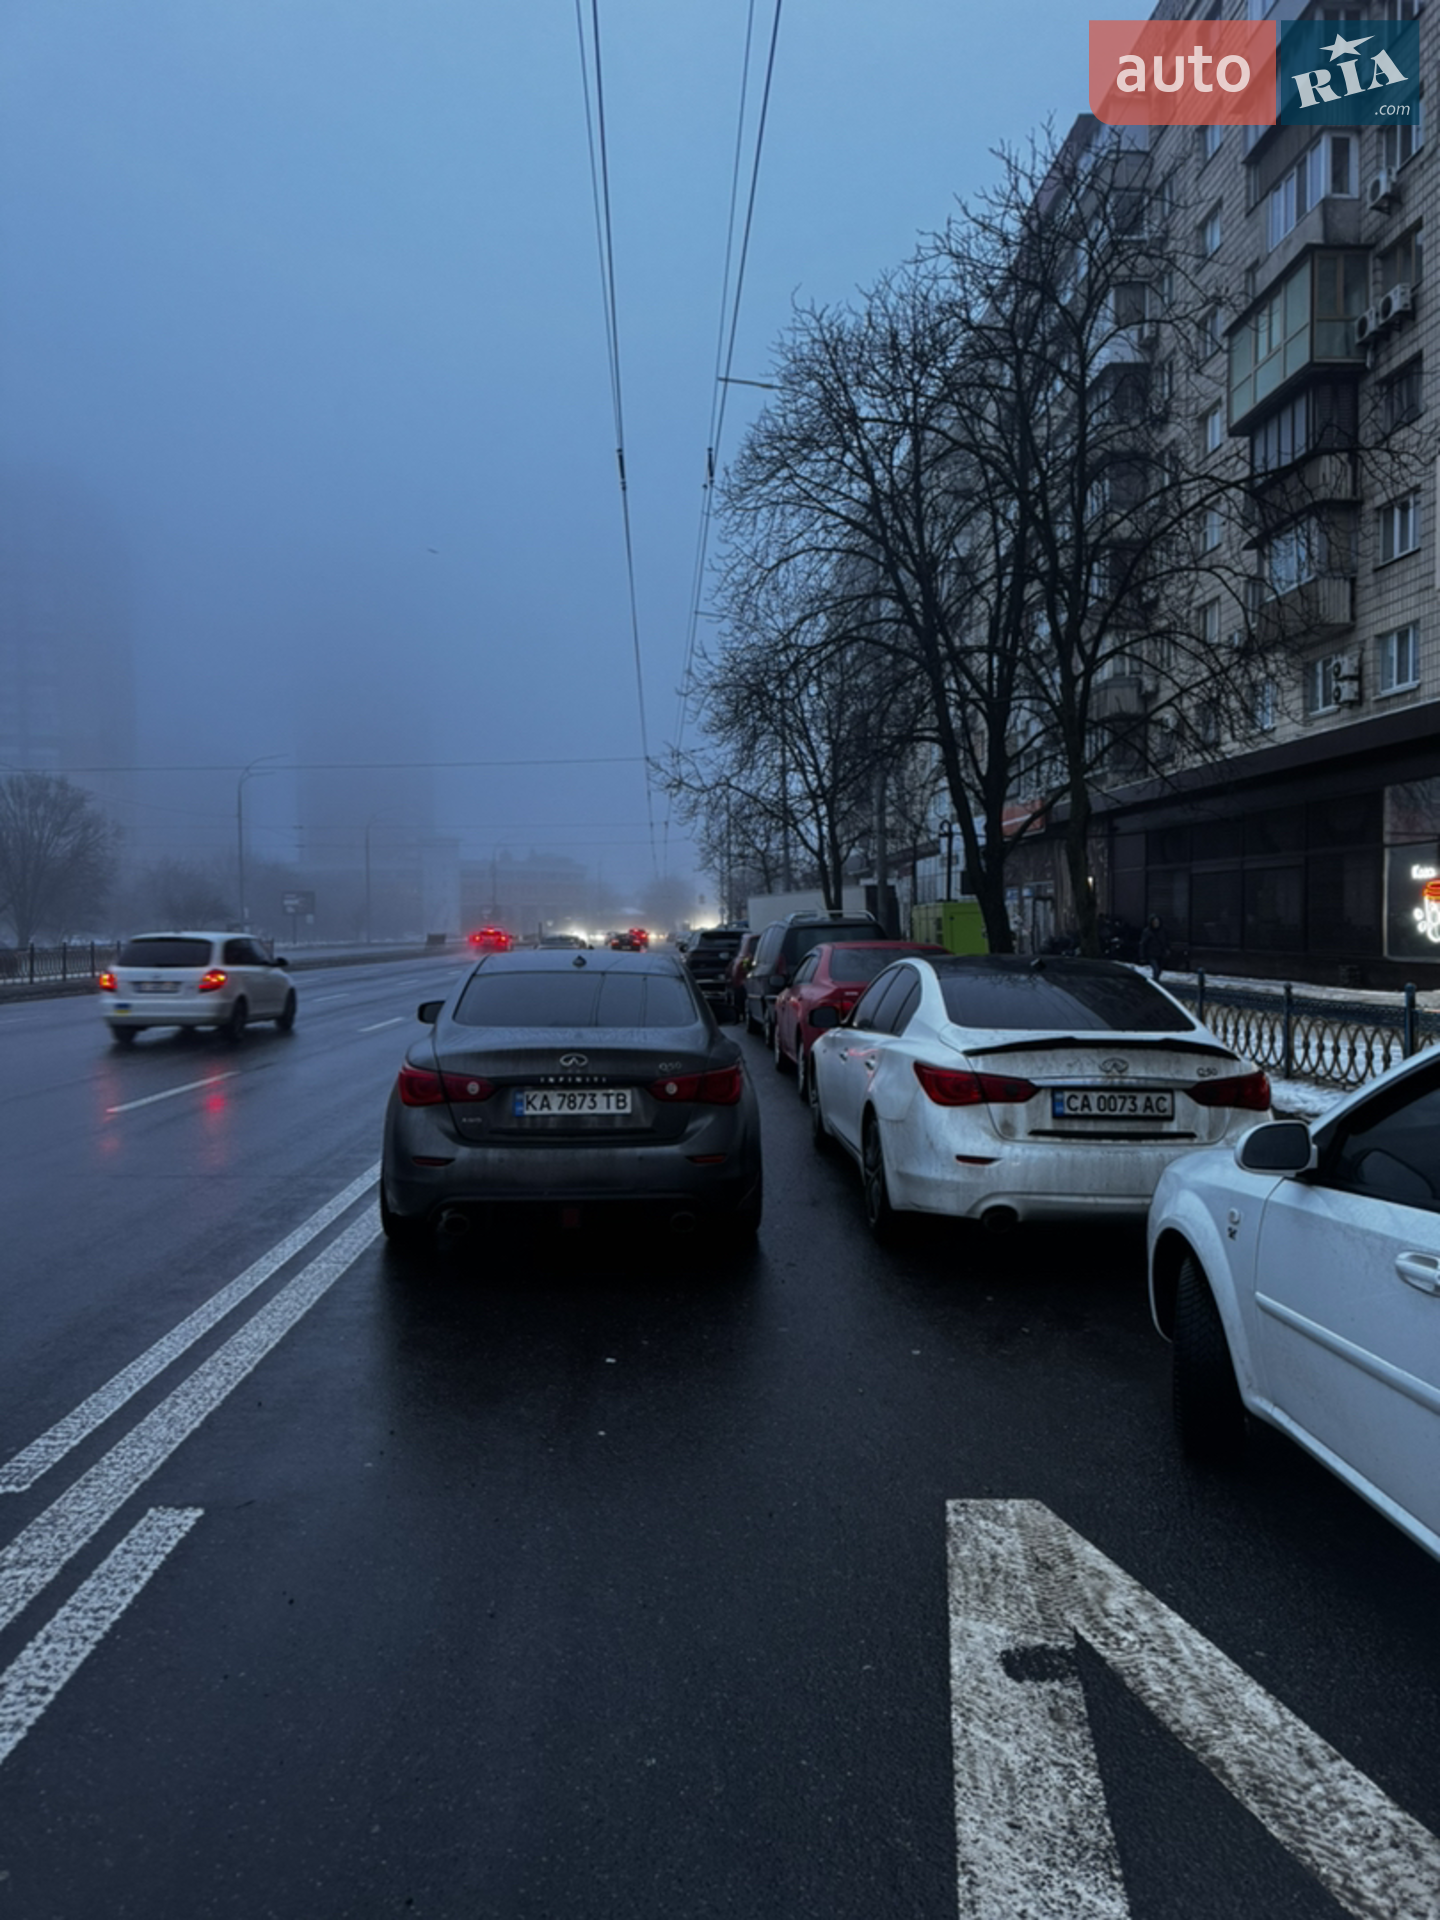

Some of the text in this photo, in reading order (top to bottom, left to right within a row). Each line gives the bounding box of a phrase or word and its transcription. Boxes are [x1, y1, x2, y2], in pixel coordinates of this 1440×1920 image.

[540, 1076, 607, 1084] INFINITI
[525, 1092, 627, 1111] KA 7873 TB
[1066, 1094, 1167, 1114] CA 0073 AC
